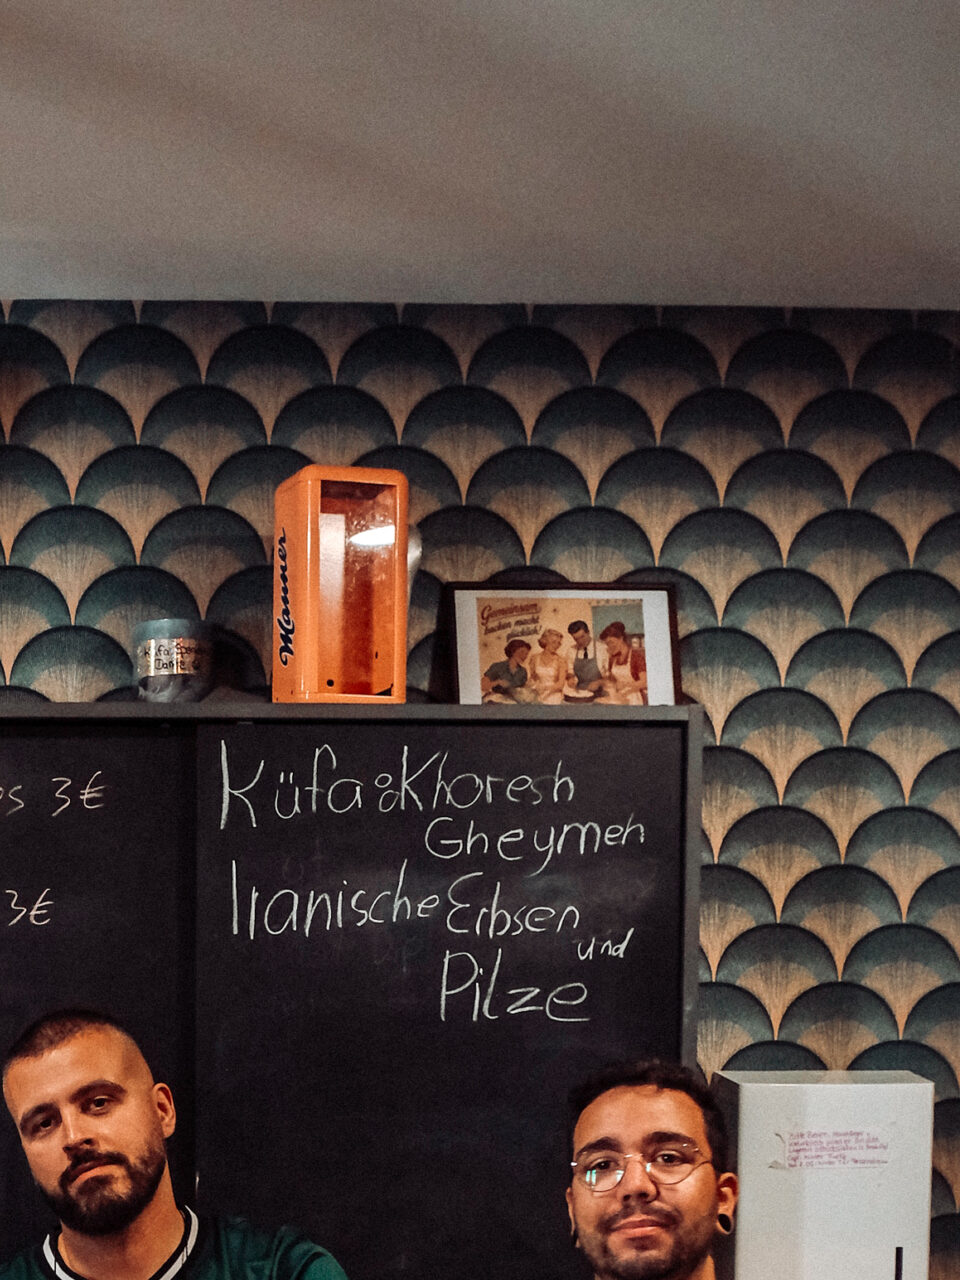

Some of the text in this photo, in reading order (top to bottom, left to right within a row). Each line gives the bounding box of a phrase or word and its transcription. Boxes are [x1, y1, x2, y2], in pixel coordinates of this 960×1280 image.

[277, 526, 296, 666] Manner
[51, 771, 107, 817] 3€
[5, 888, 54, 926] 3€
[446, 871, 580, 939] Erbsen
[577, 927, 634, 961] und
[439, 947, 591, 1022] Pilze
